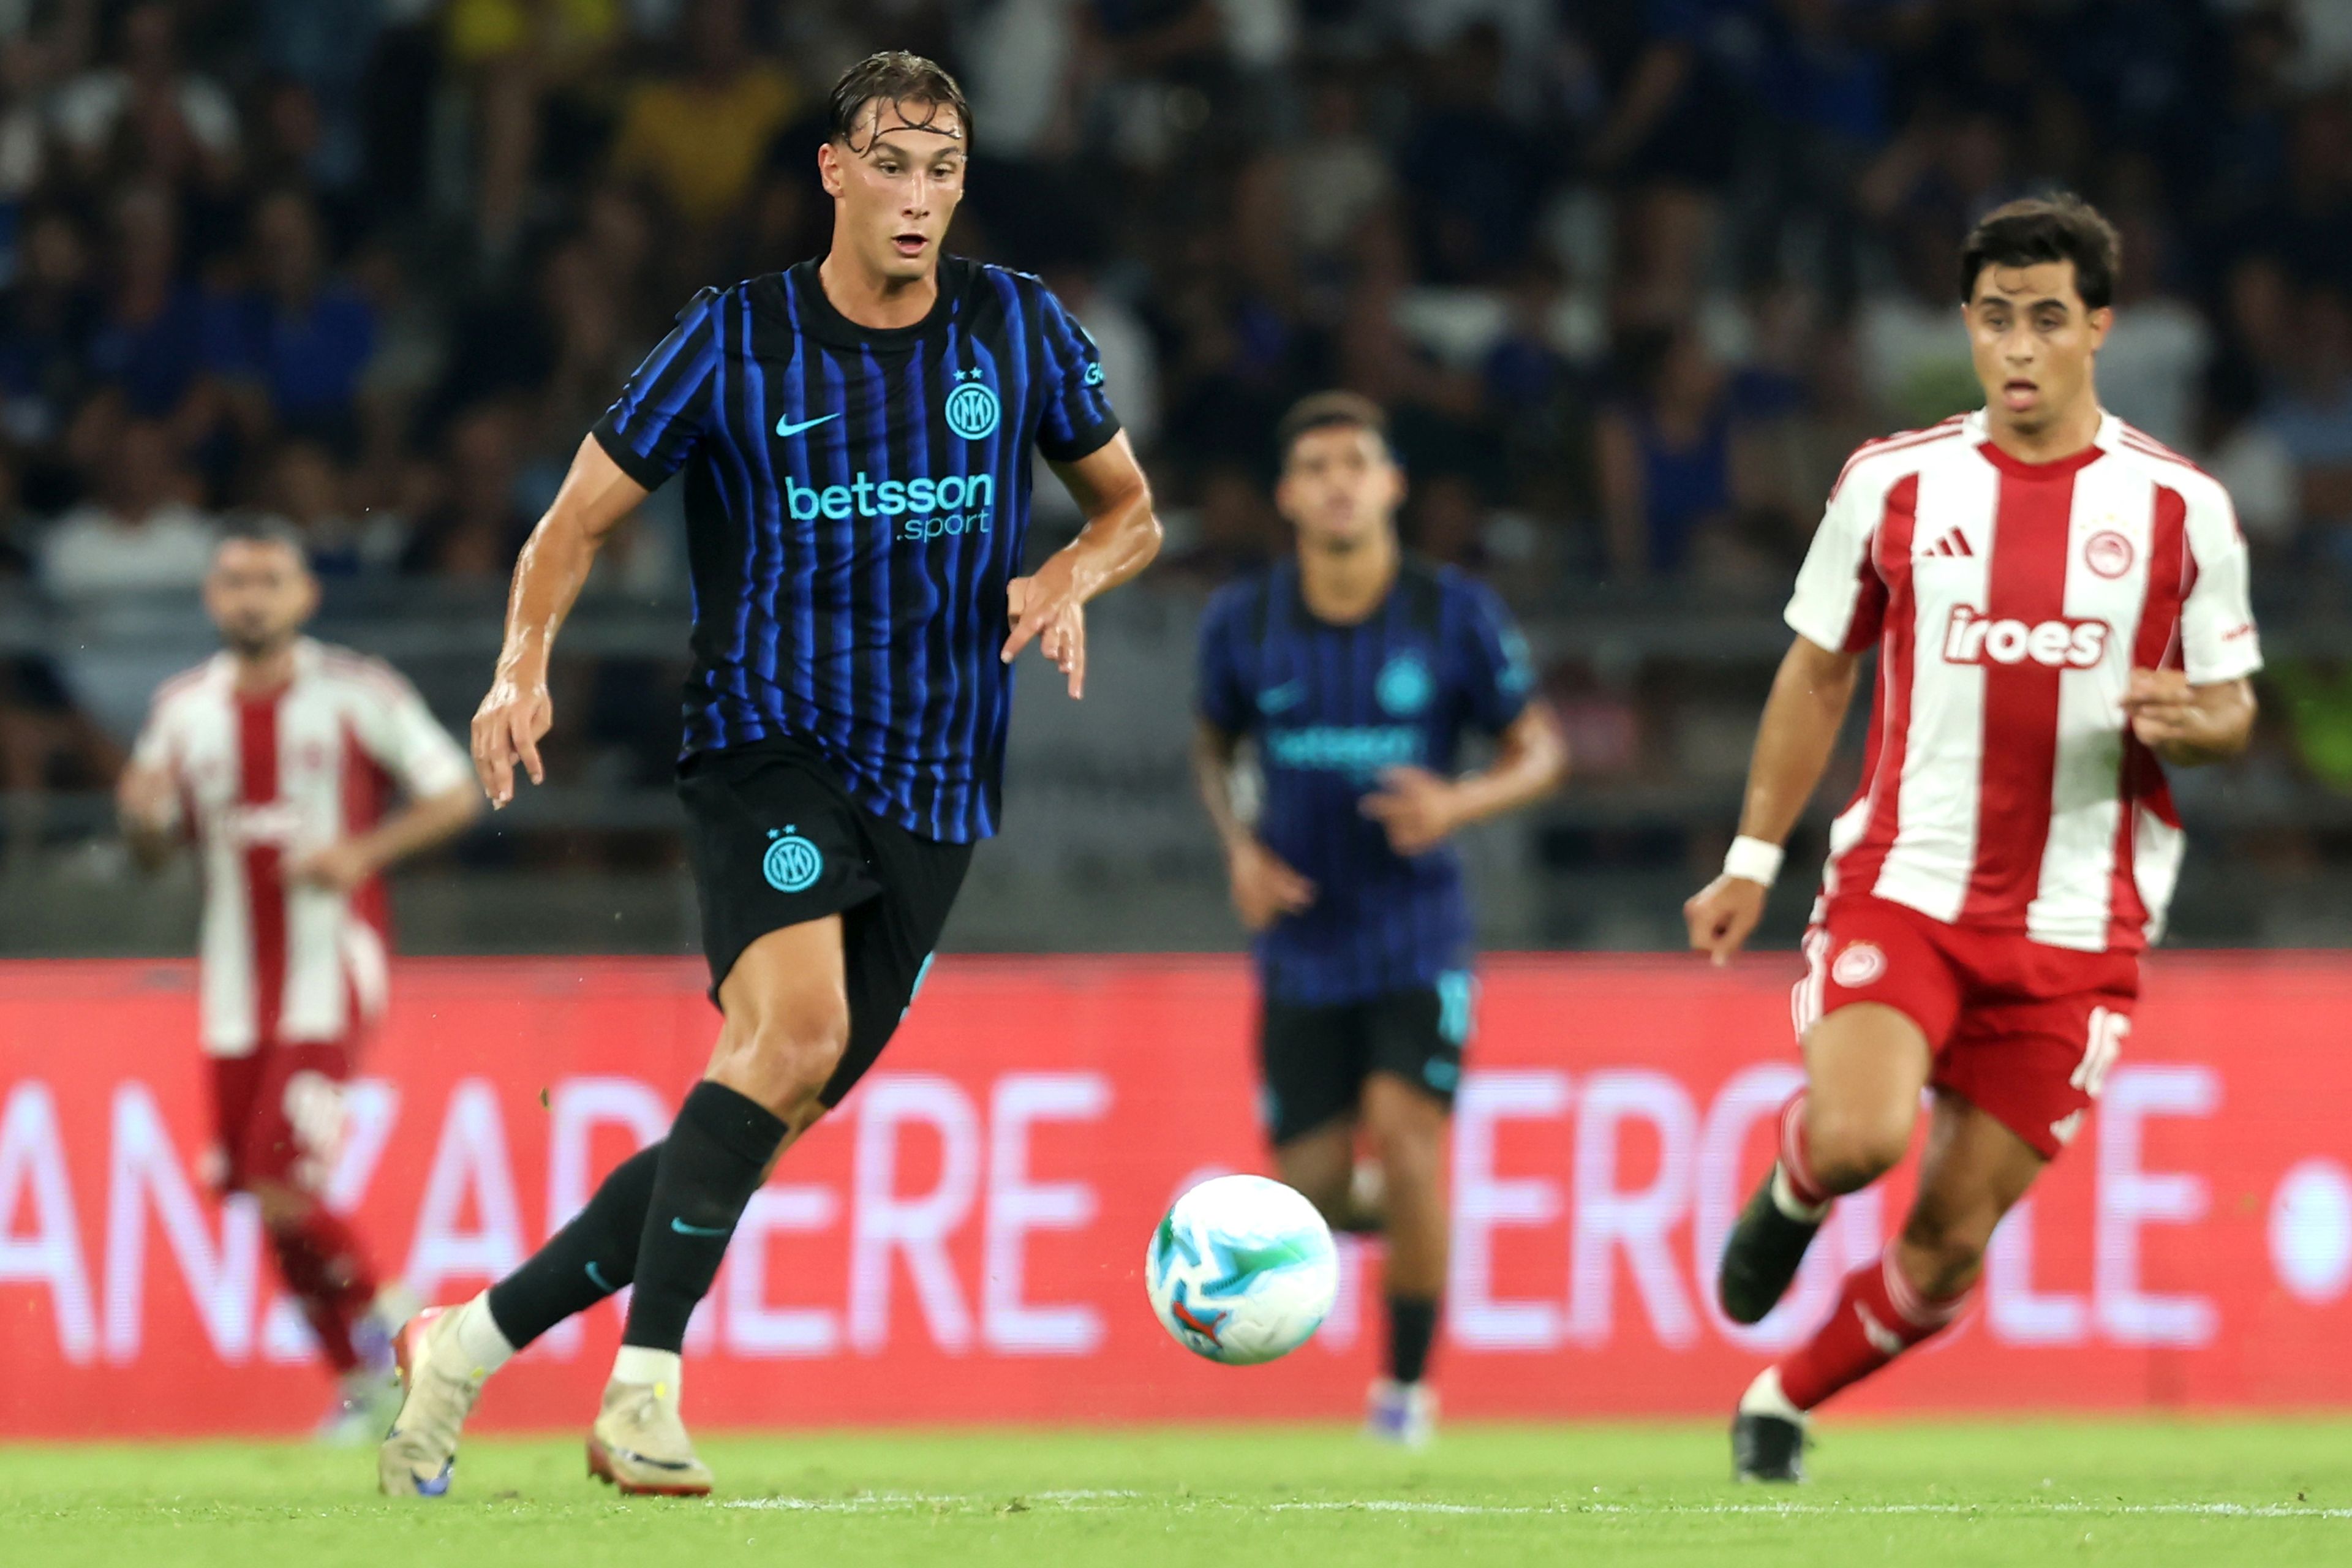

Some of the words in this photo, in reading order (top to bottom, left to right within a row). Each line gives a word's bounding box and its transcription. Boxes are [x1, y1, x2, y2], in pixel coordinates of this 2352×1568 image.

[785, 472, 992, 521] betsson
[895, 508, 990, 543] .sport
[1943, 605, 2108, 668] iroes
